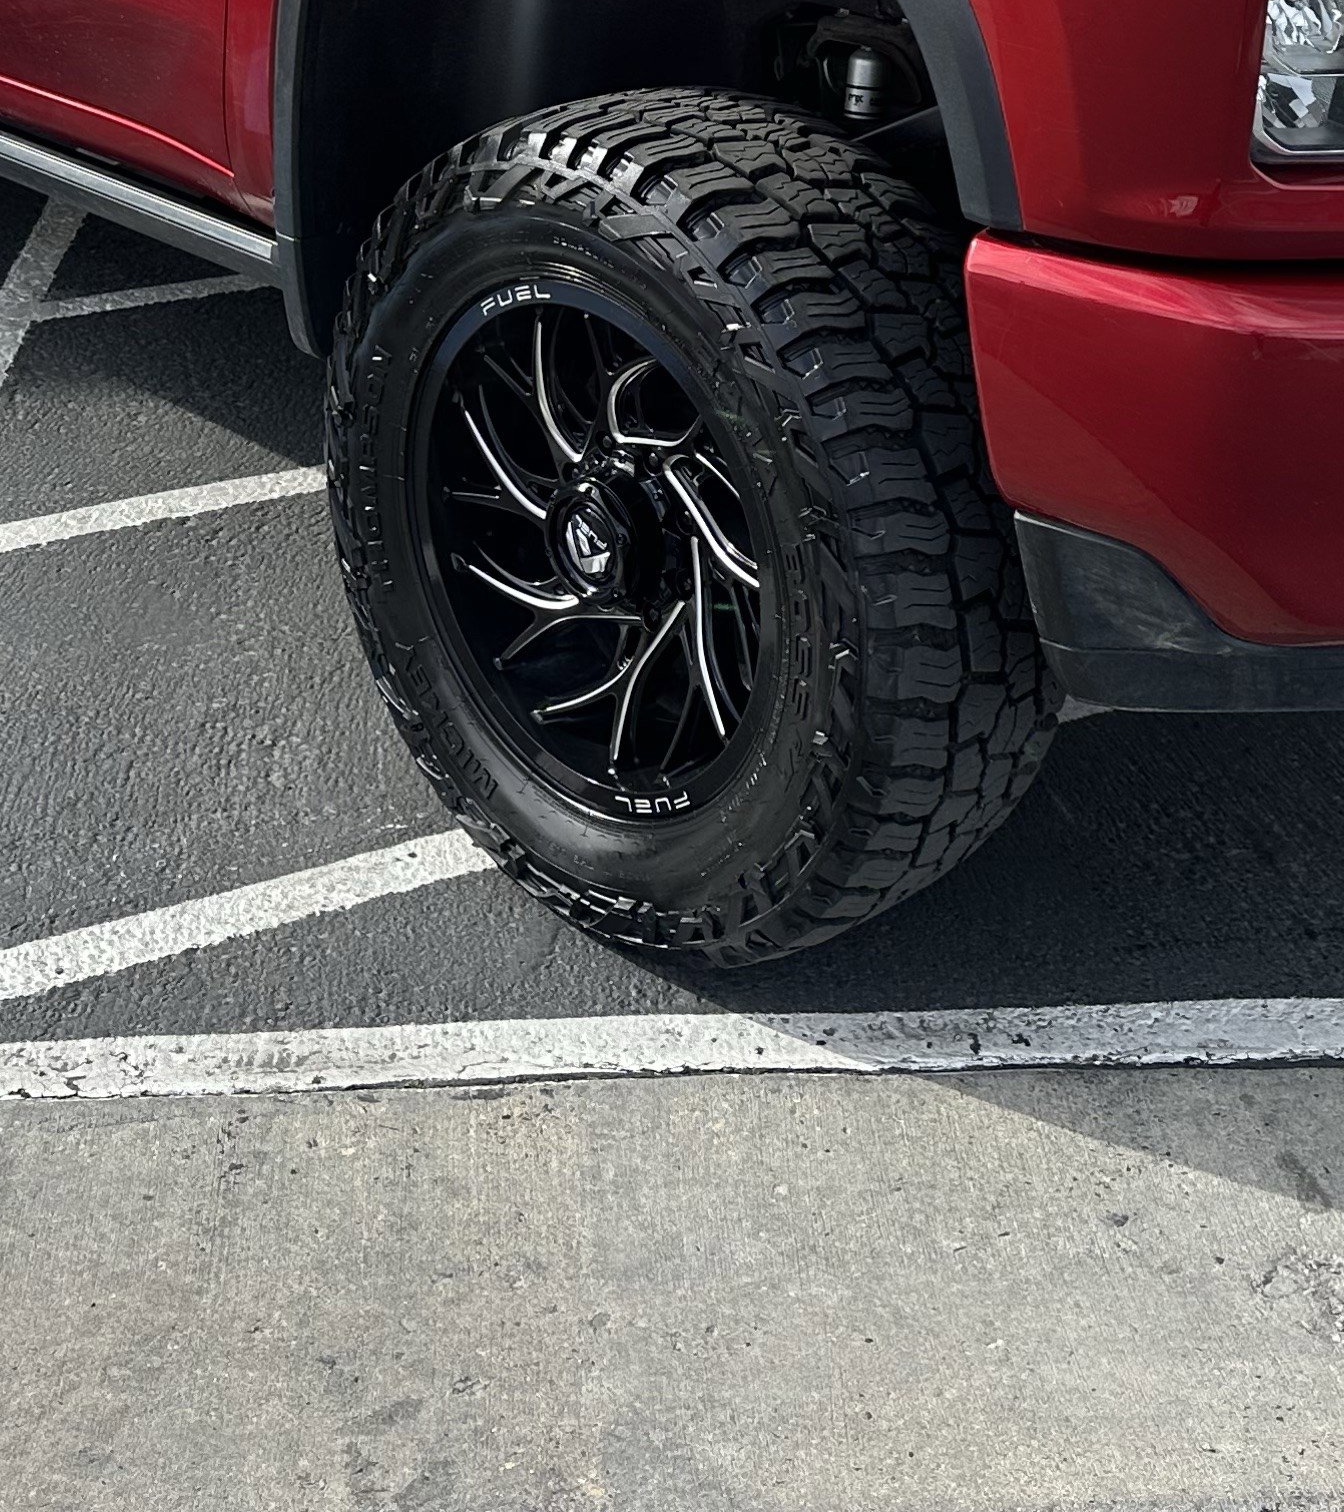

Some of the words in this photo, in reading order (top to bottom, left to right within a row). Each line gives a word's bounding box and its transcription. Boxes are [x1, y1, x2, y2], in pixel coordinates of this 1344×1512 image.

[480, 284, 551, 317] FUEL
[575, 514, 608, 551] FUEL
[394, 635, 500, 801] MICKEY
[614, 790, 691, 813] FUEL
